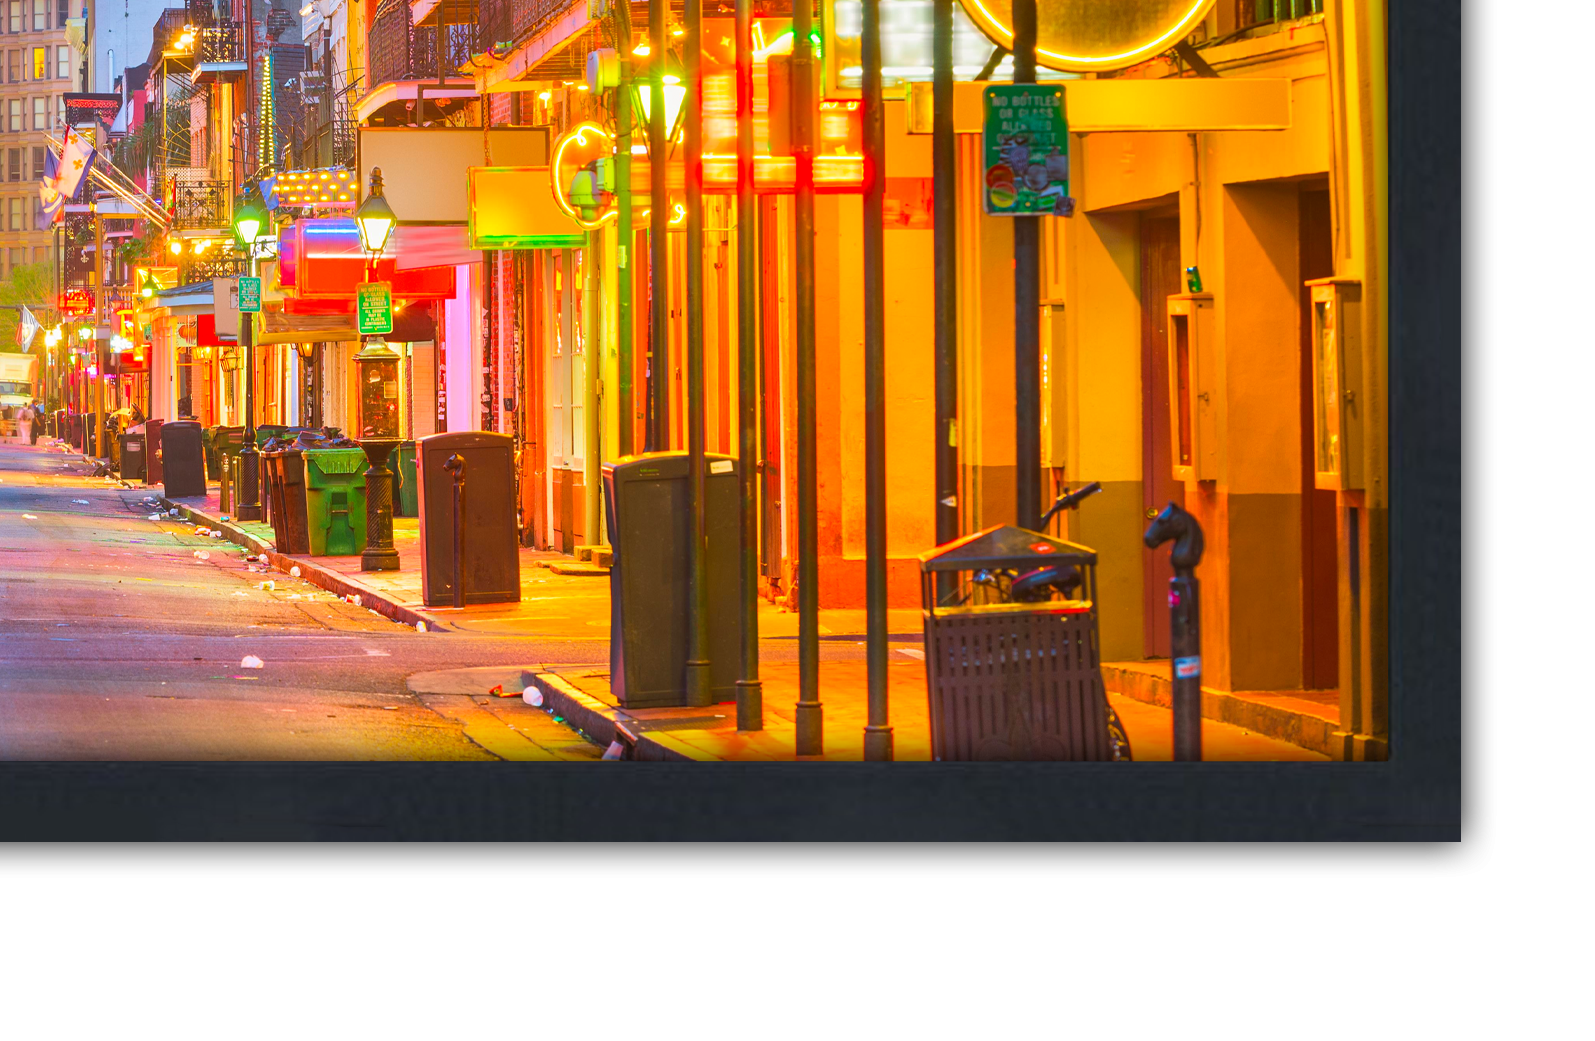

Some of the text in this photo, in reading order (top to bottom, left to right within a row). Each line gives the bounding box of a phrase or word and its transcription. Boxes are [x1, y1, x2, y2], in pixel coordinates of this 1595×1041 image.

[992, 96, 1060, 107] NO BOTTLES
[999, 108, 1054, 119] OR GLASS
